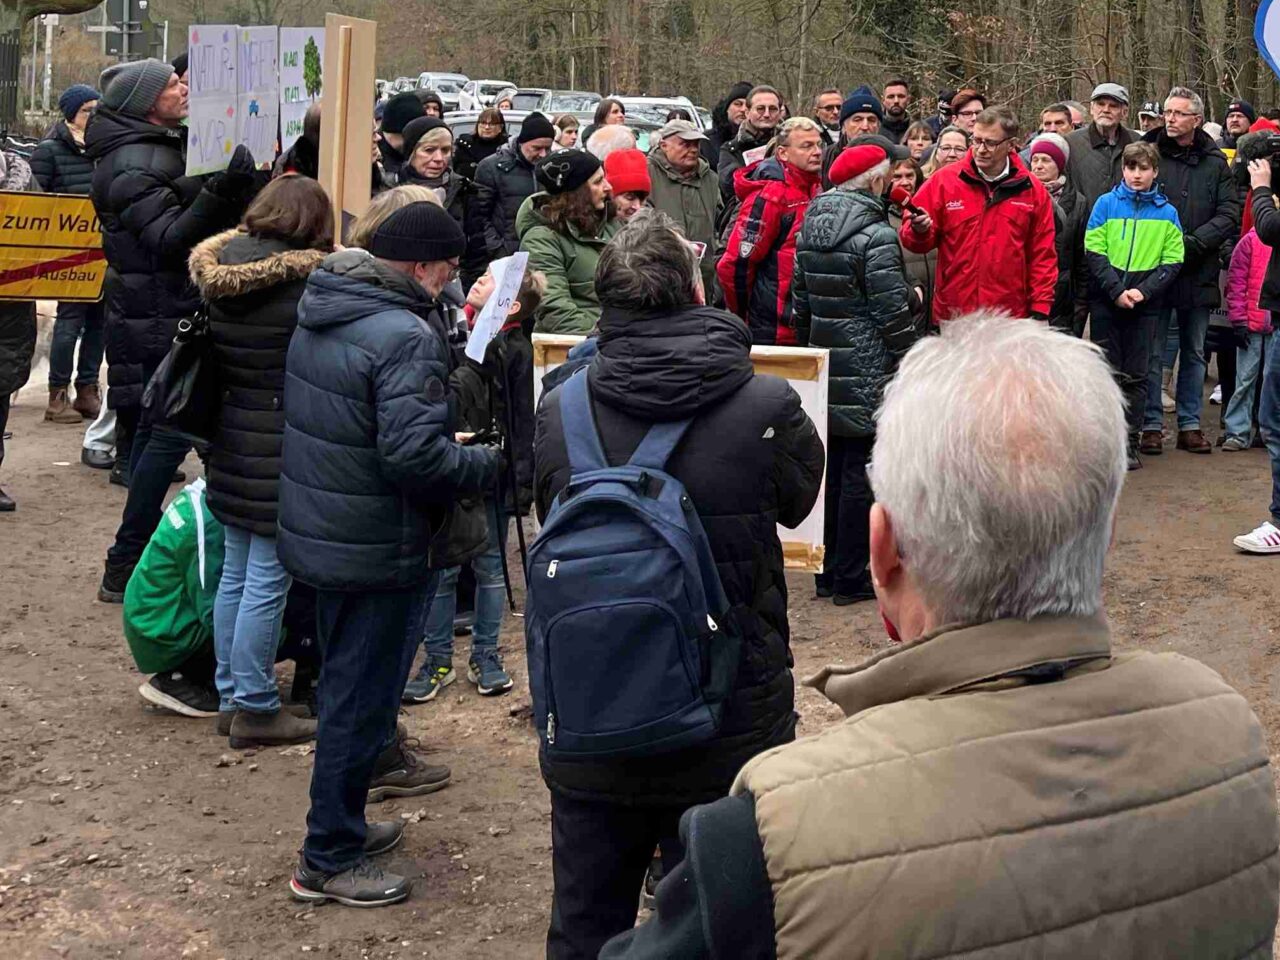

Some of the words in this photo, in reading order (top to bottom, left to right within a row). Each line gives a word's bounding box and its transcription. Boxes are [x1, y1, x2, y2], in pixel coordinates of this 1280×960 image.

[2, 215, 50, 232] zum
[59, 213, 103, 234] Wal
[38, 267, 97, 282] Ausbau
